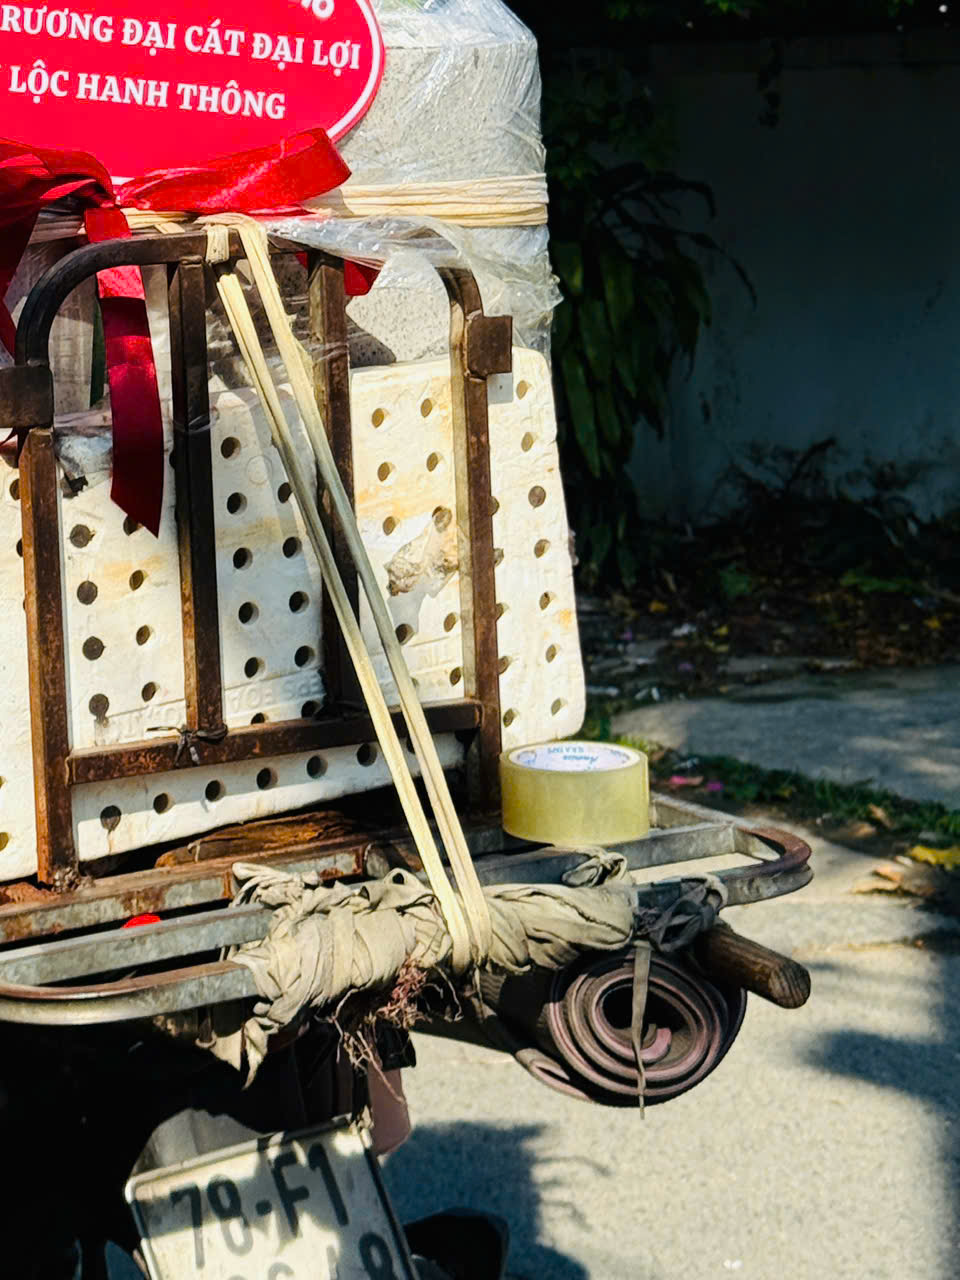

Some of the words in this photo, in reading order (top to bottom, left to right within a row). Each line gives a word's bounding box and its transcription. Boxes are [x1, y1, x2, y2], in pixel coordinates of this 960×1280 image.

[121, 18, 177, 57] ĐẠI
[184, 19, 245, 57] CÁT
[251, 32, 305, 71] ĐẠI
[311, 38, 361, 78] LỢI
[8, 58, 70, 105] LỘC
[75, 72, 170, 109] HANH
[176, 79, 286, 121] THÔNG
